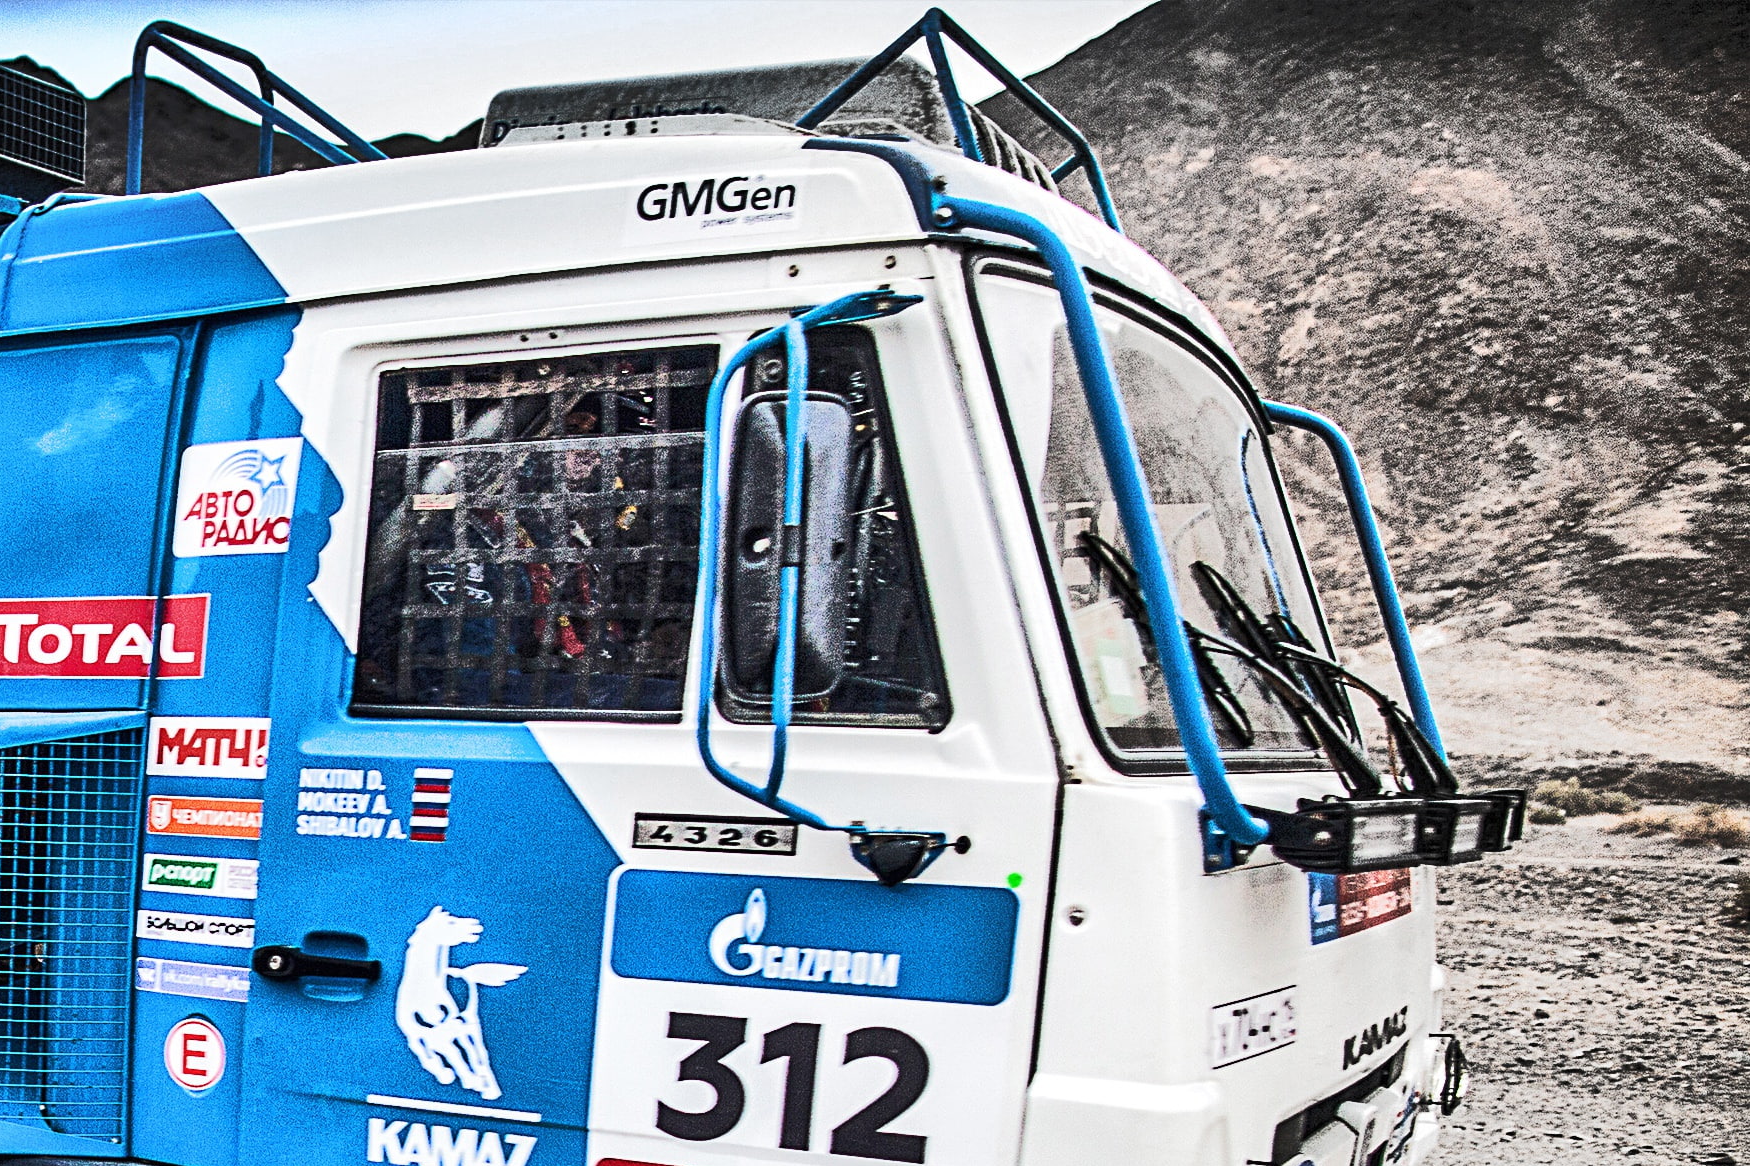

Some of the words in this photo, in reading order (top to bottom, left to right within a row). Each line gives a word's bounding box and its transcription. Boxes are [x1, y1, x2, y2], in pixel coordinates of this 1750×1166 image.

[636, 176, 796, 221] GMGen
[184, 489, 254, 520] АВТО
[200, 516, 290, 548] РАДИО
[299, 768, 364, 789] NIKITIN
[298, 792, 370, 814] MOKEEV
[371, 794, 392, 815] A.
[296, 815, 386, 838] SHIBALOV
[386, 818, 407, 840] A.
[763, 945, 900, 987] GAZPROM
[182, 1033, 208, 1075] E
[655, 1011, 931, 1164] 312
